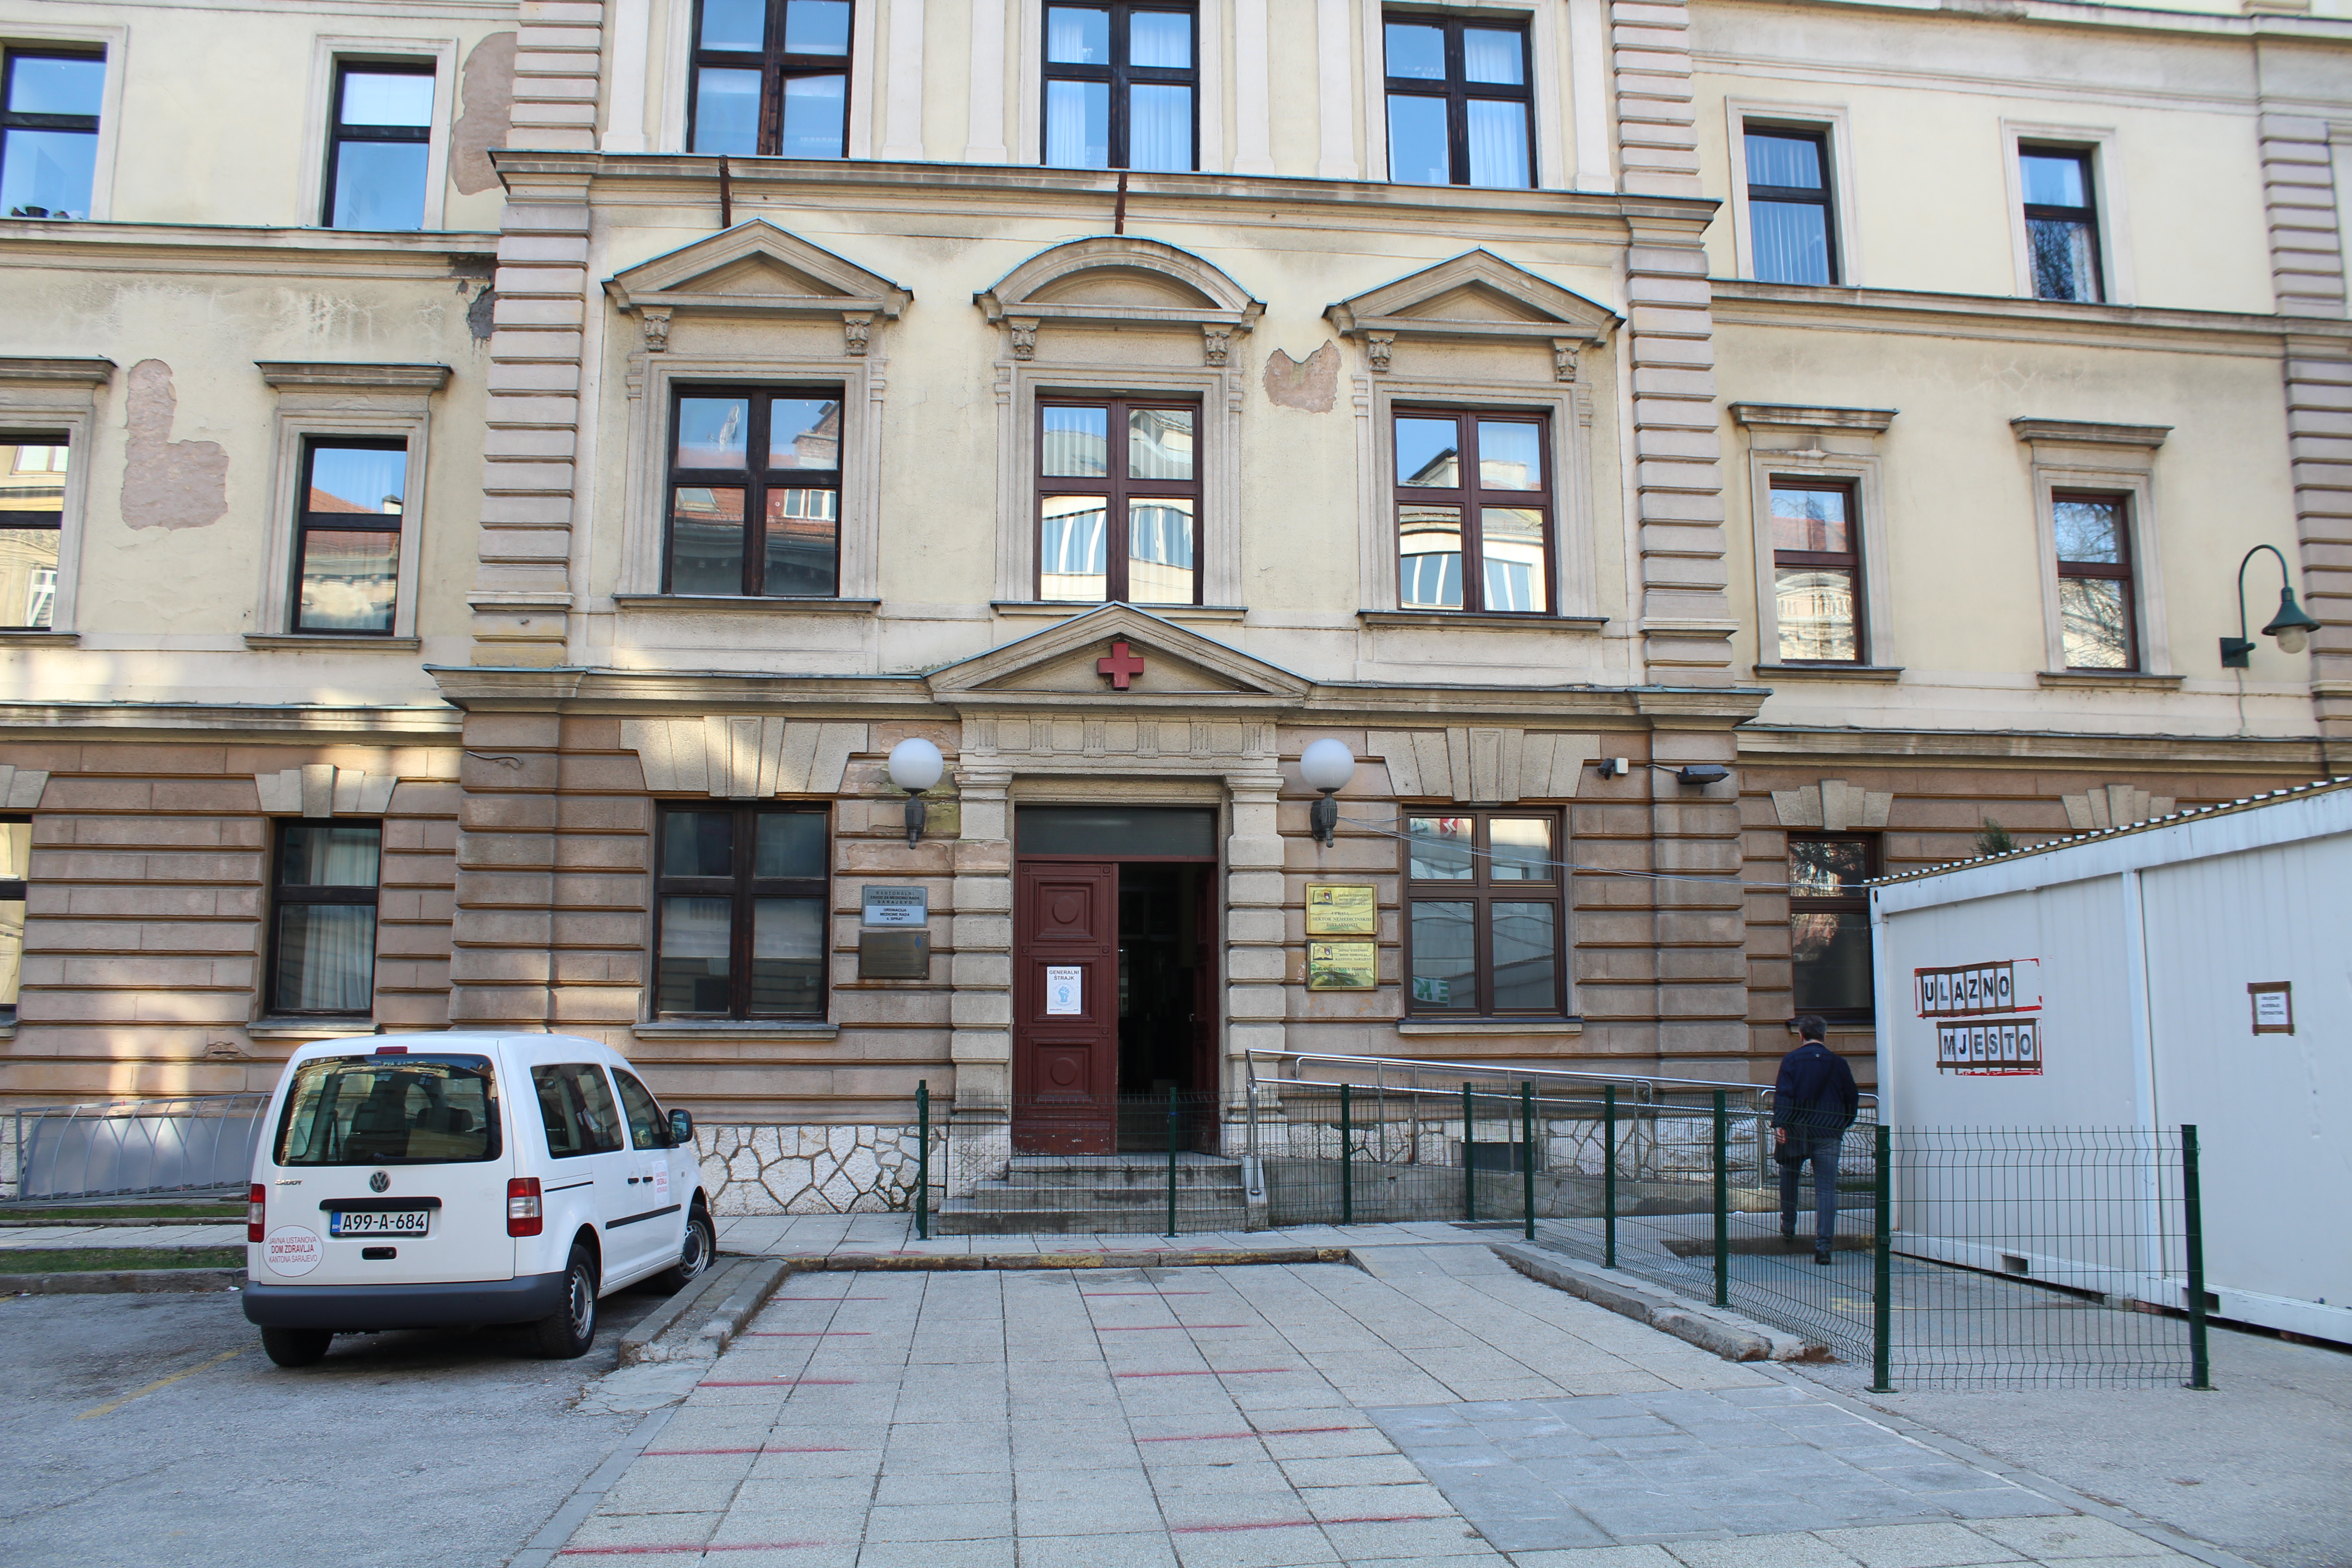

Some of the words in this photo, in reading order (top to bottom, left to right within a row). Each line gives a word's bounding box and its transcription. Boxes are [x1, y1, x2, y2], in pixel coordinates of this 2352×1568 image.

[1925, 976, 2009, 1001] ULAZNO
[1944, 1033, 2032, 1055] MJESTO
[343, 1214, 424, 1230] A99-A-684
[271, 1245, 284, 1254] DOM
[284, 1244, 314, 1253] ZDRAVLJA
[292, 1254, 318, 1263] SARAJEVO
